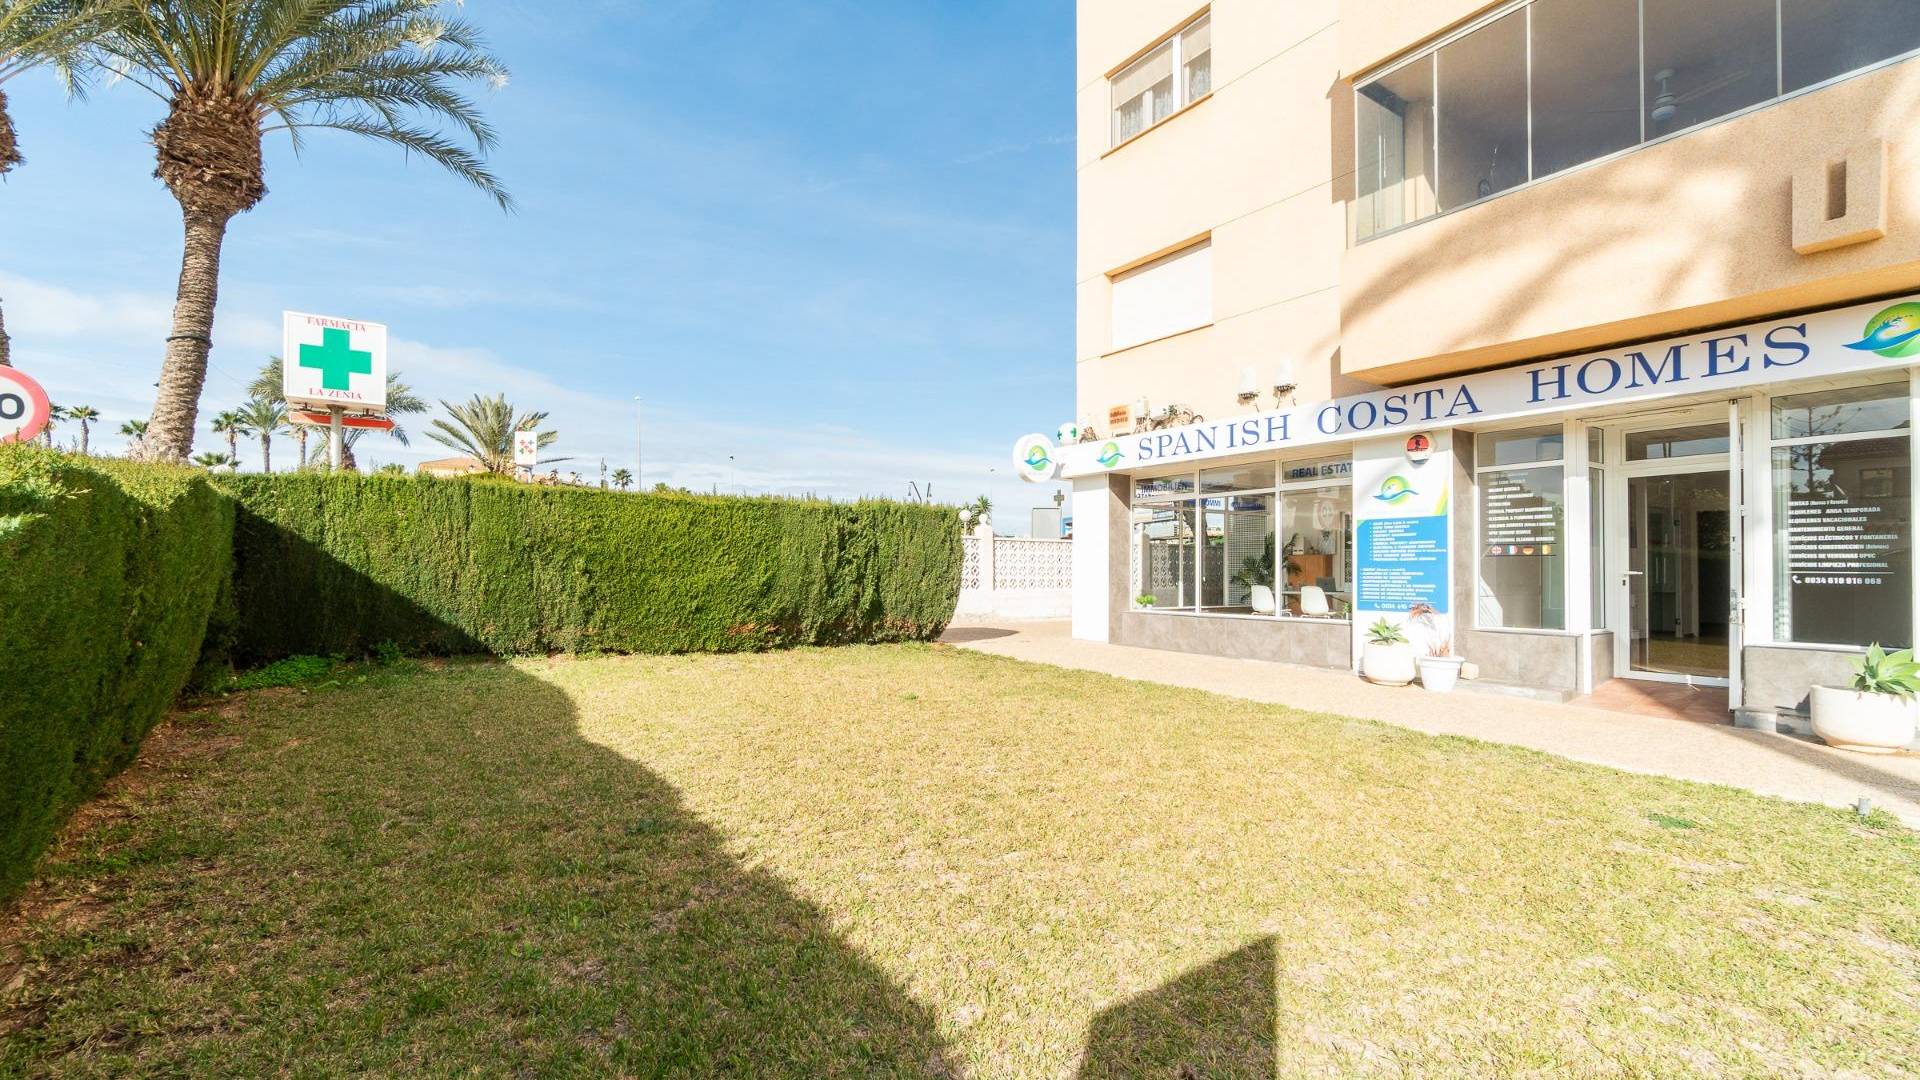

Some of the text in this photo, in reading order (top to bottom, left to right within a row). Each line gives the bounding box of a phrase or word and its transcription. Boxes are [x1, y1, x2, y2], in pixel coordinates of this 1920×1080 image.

[304, 316, 367, 332] FARMACIA
[328, 389, 363, 400] ZENIA
[1138, 323, 1810, 462] SPANISH COSTA HOMES
[1292, 467, 1319, 478] REAL
